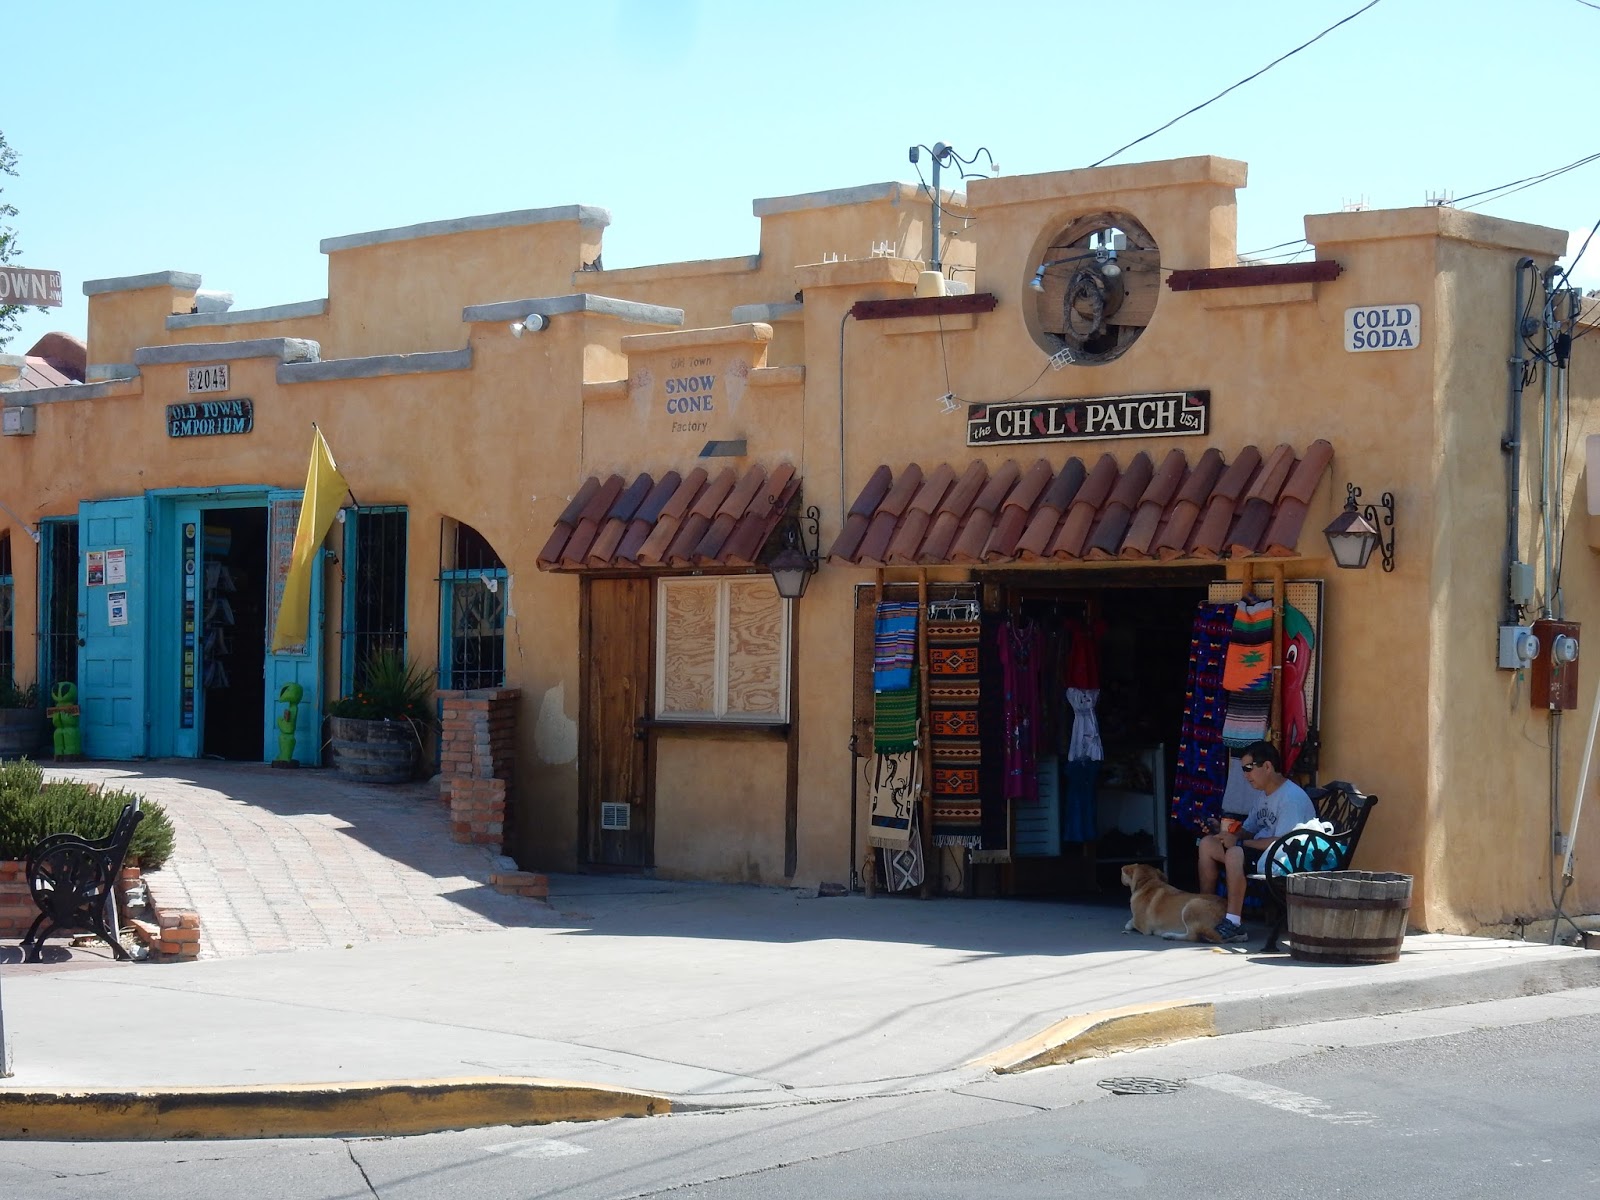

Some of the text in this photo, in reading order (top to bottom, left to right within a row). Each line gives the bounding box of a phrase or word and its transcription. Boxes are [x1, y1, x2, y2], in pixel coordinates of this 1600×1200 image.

[1353, 308, 1412, 329] COLD
[1353, 329, 1413, 349] SODA
[665, 375, 715, 394] SNOW
[172, 400, 243, 419] OLD TOWN
[667, 395, 713, 414] CONE
[172, 417, 245, 437] EMPORIUM
[671, 421, 707, 433] Factory
[972, 426, 991, 439] the
[1085, 400, 1177, 433] PATCH
[1180, 412, 1199, 428] USA
